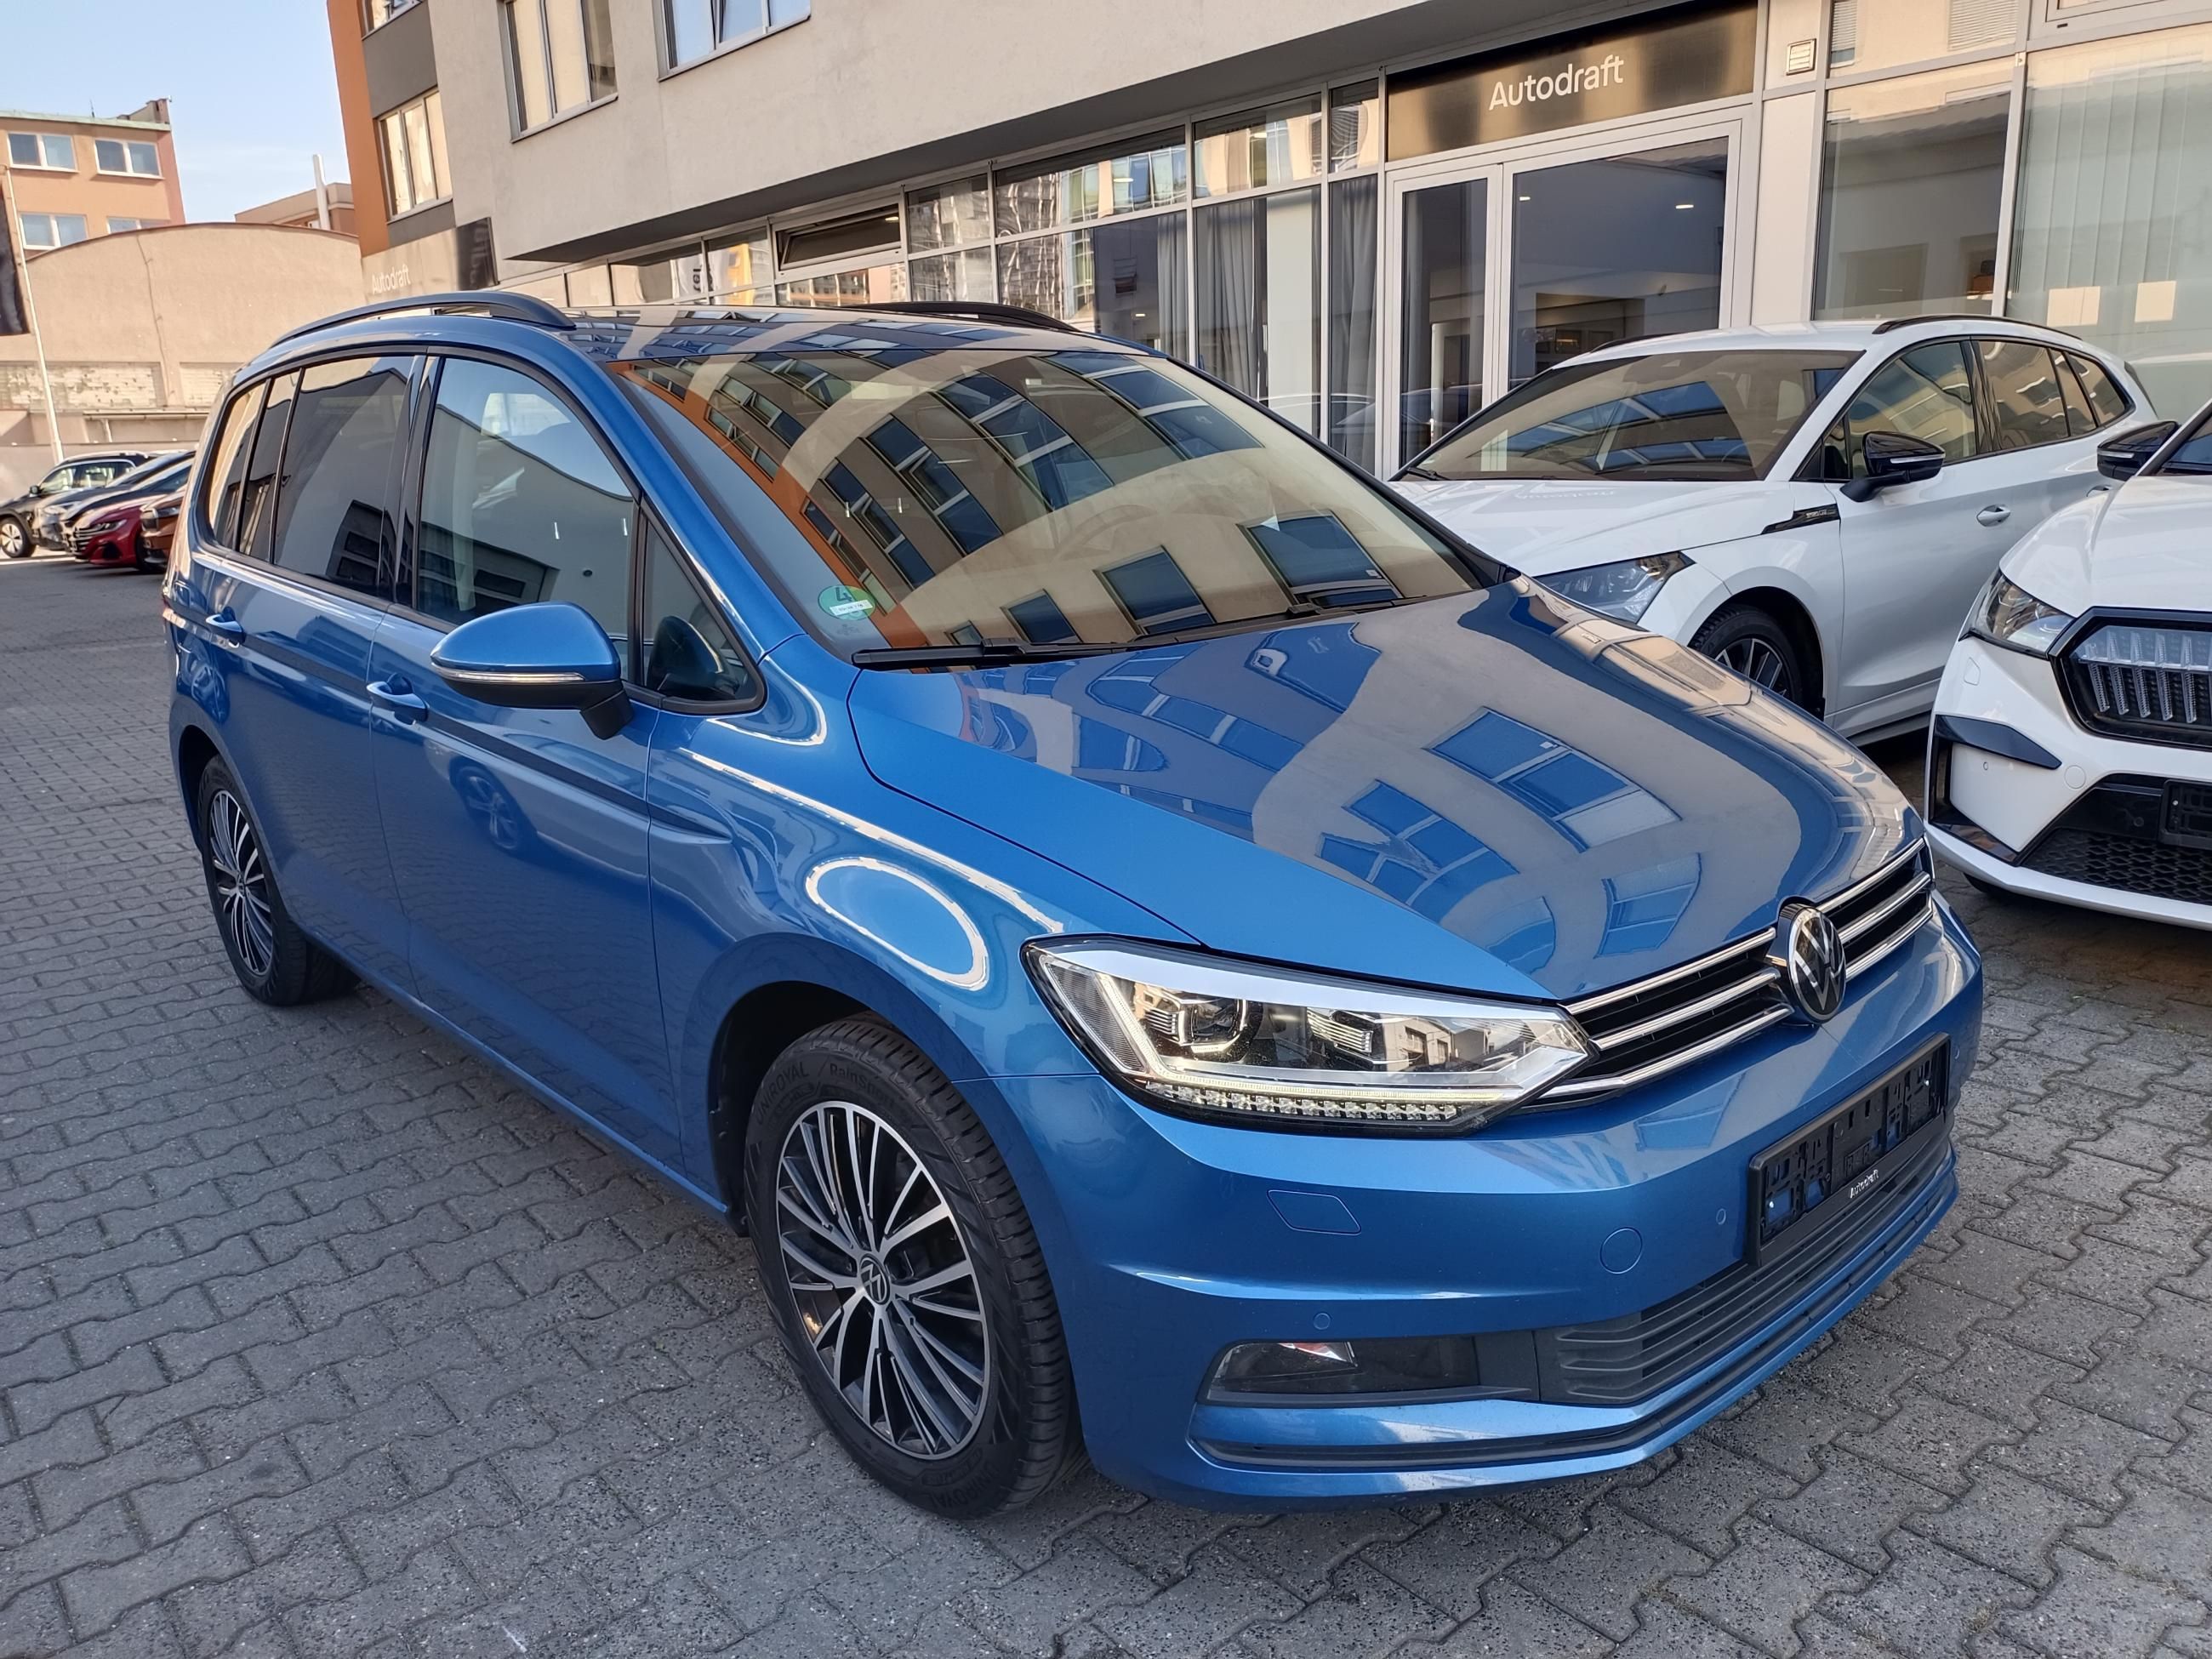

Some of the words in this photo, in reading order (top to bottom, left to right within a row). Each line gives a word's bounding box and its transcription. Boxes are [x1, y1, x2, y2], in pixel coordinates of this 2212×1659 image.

[1489, 54, 1624, 111] Autodraft
[372, 264, 411, 295] Autodraft
[756, 1061, 810, 1125] UNIROYAL
